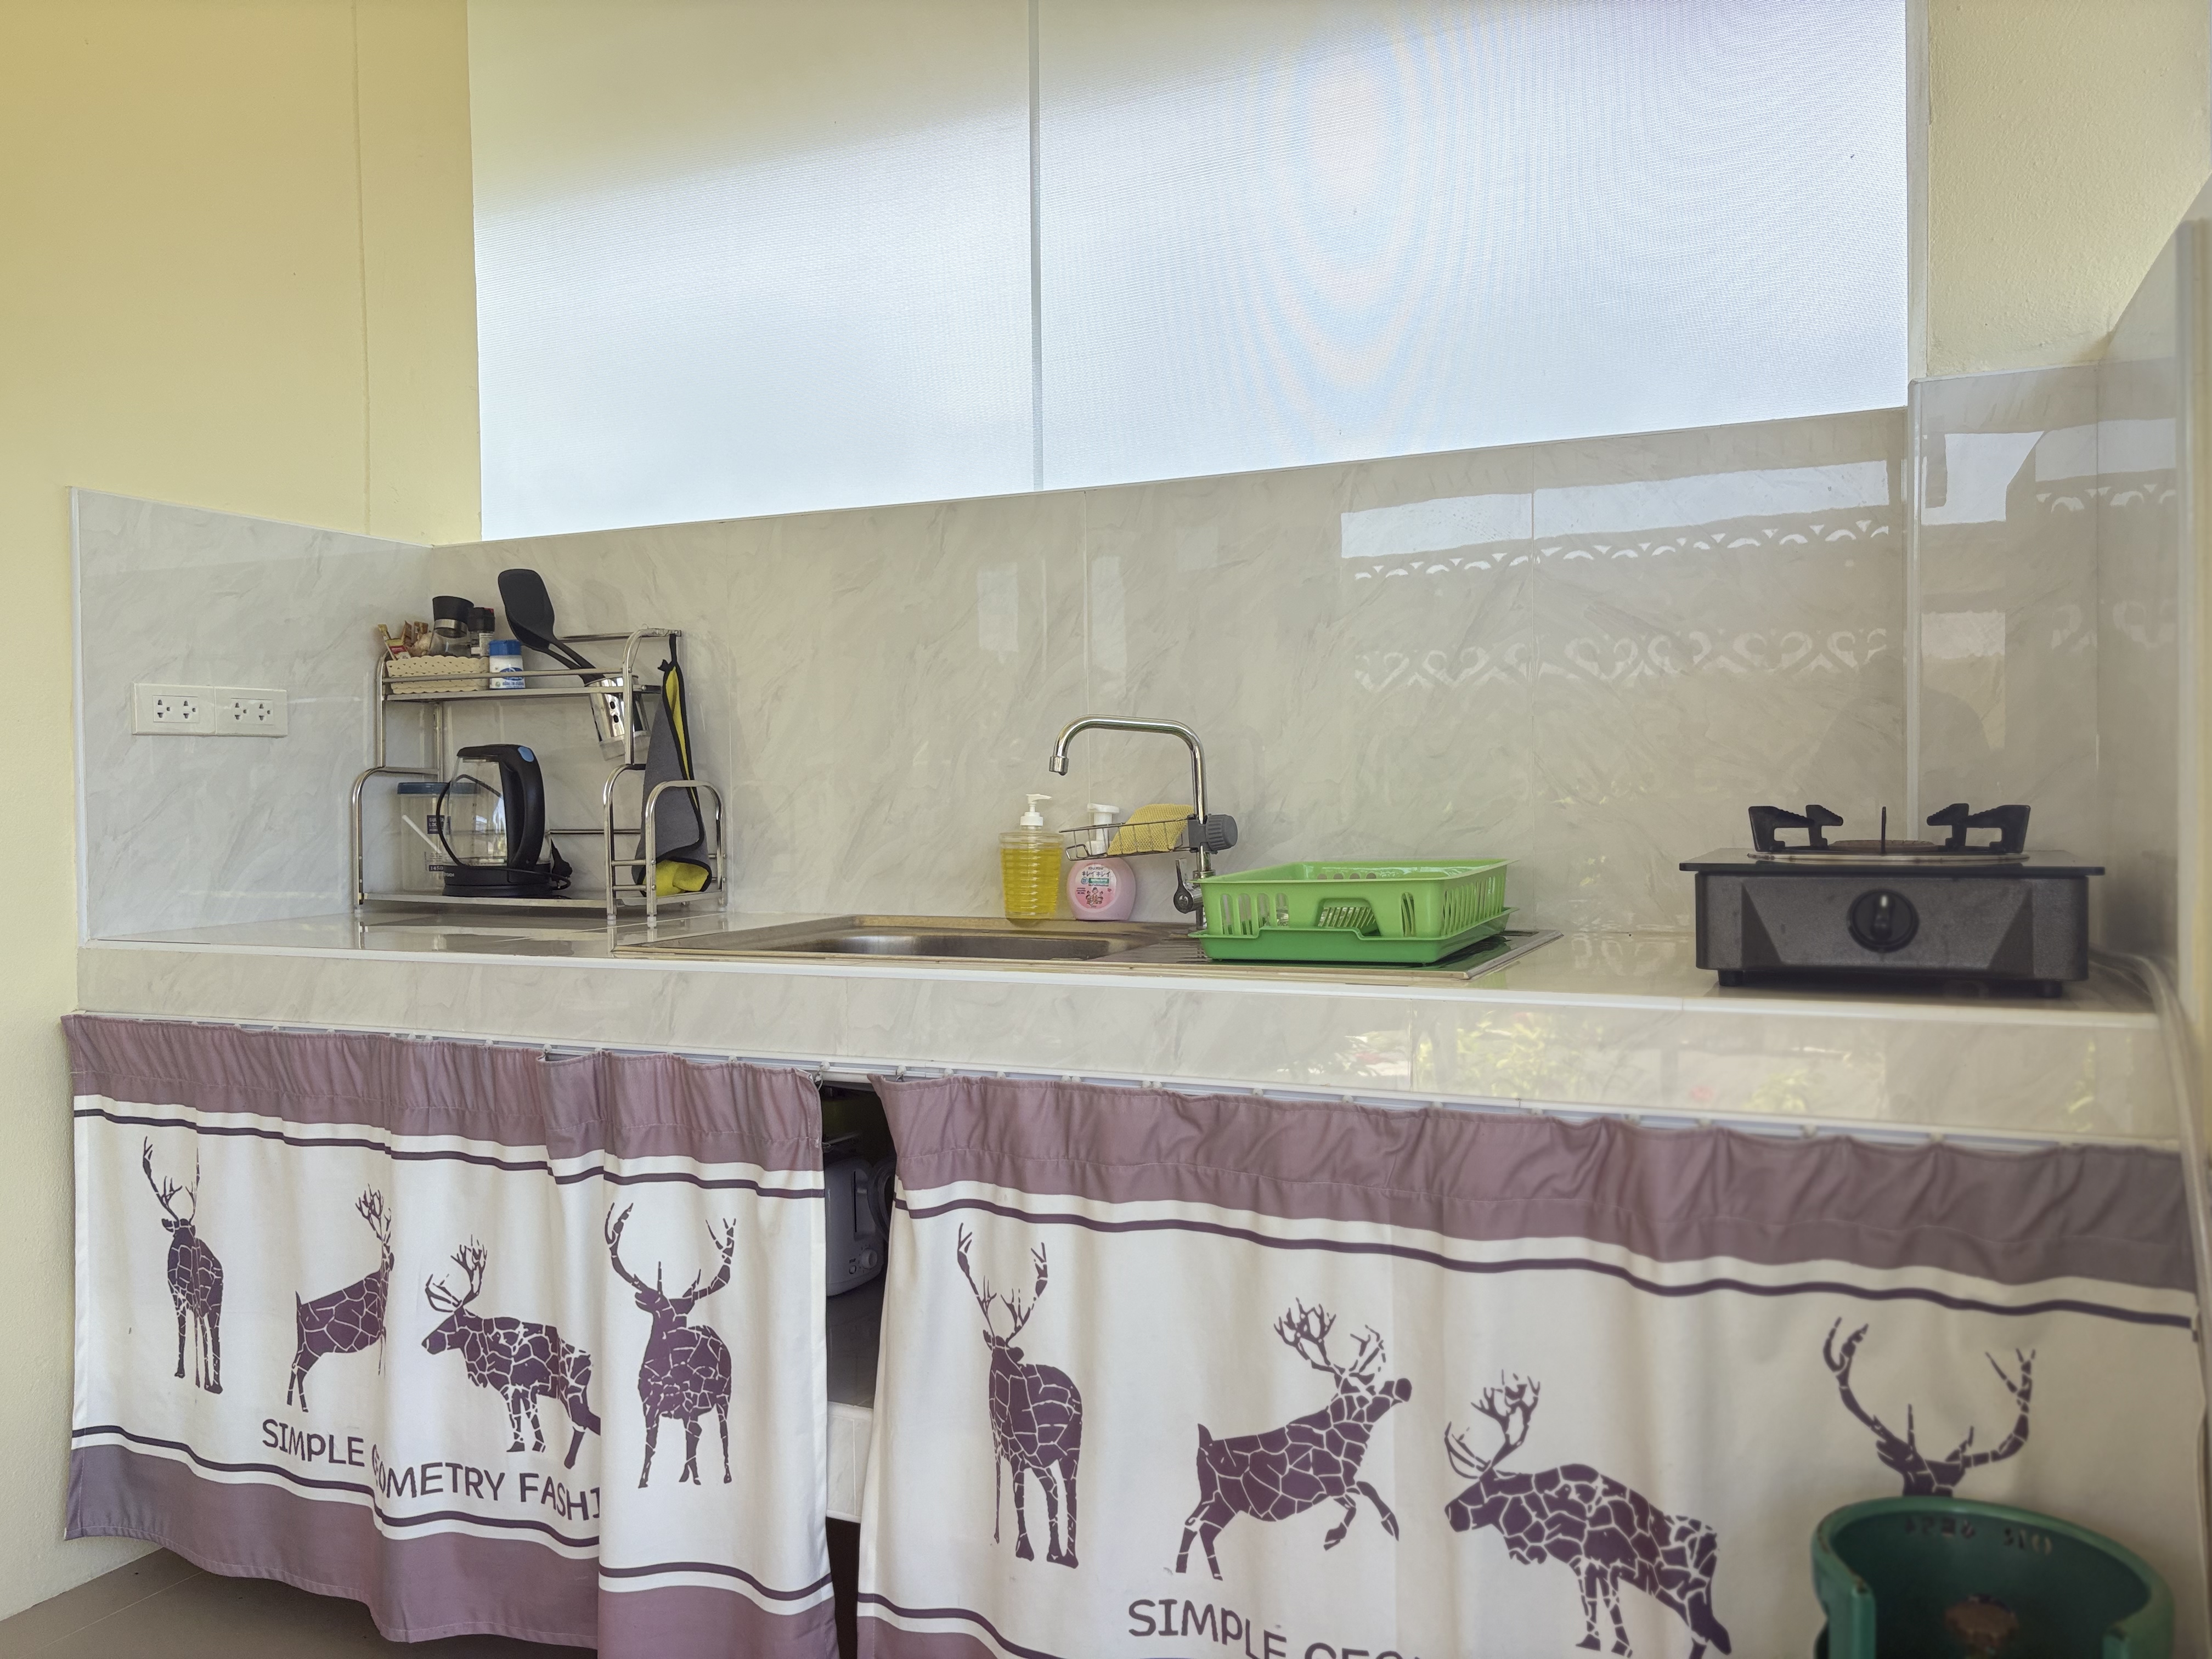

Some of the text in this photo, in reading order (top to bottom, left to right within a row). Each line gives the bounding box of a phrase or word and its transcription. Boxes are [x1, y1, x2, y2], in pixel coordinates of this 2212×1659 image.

[262, 1419, 364, 1467] SIMPLE
[371, 1443, 505, 1501] GOMETRY
[1128, 1599, 1287, 1659] SIMPLE
